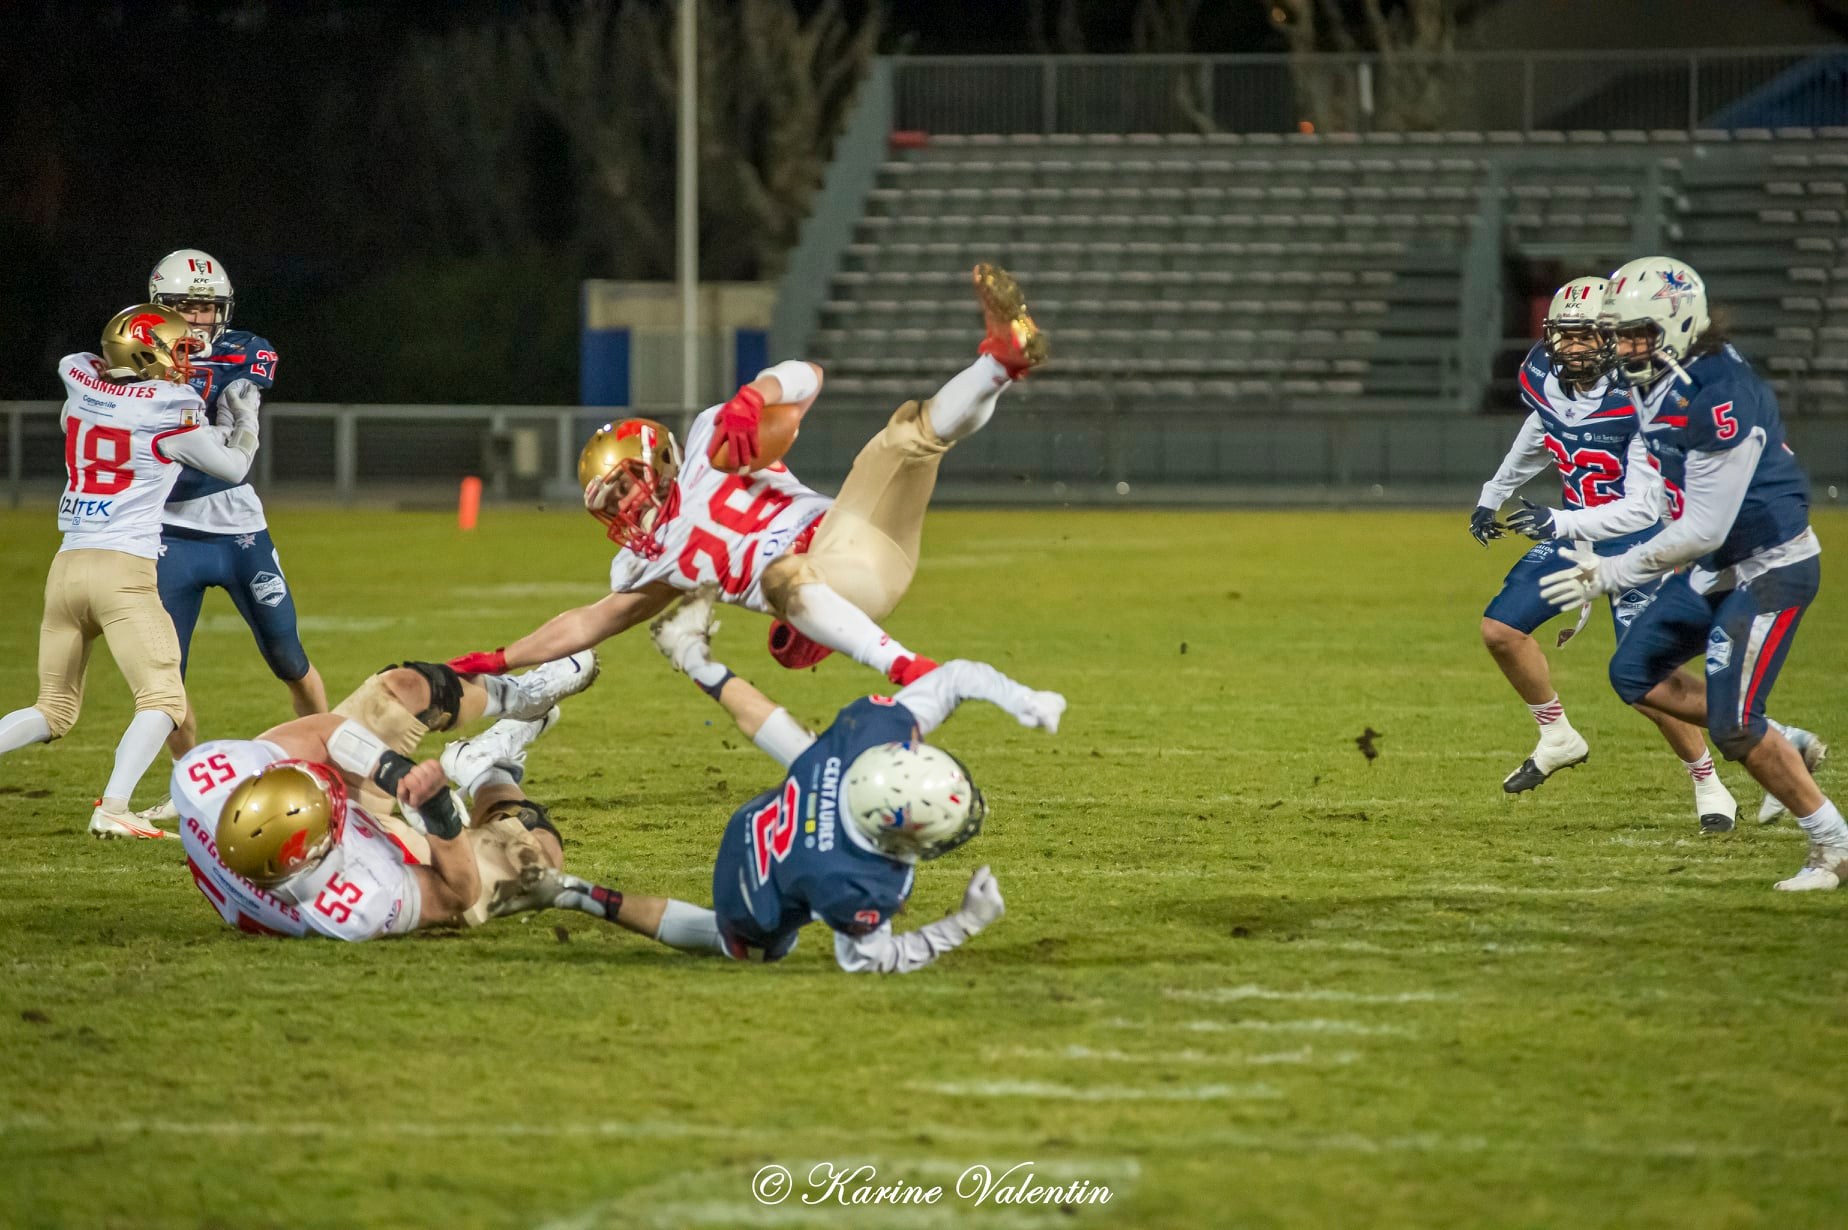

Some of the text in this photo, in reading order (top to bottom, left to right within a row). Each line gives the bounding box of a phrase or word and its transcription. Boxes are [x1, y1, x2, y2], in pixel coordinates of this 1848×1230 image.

[68, 367, 157, 399] ARGONAUTES
[250, 349, 279, 381] 27
[1711, 400, 1739, 440] 5
[65, 416, 135, 496] 18
[187, 753, 237, 795] 55
[818, 757, 841, 852] CENTAURES
[752, 775, 801, 886] 2
[313, 871, 364, 924] 55
